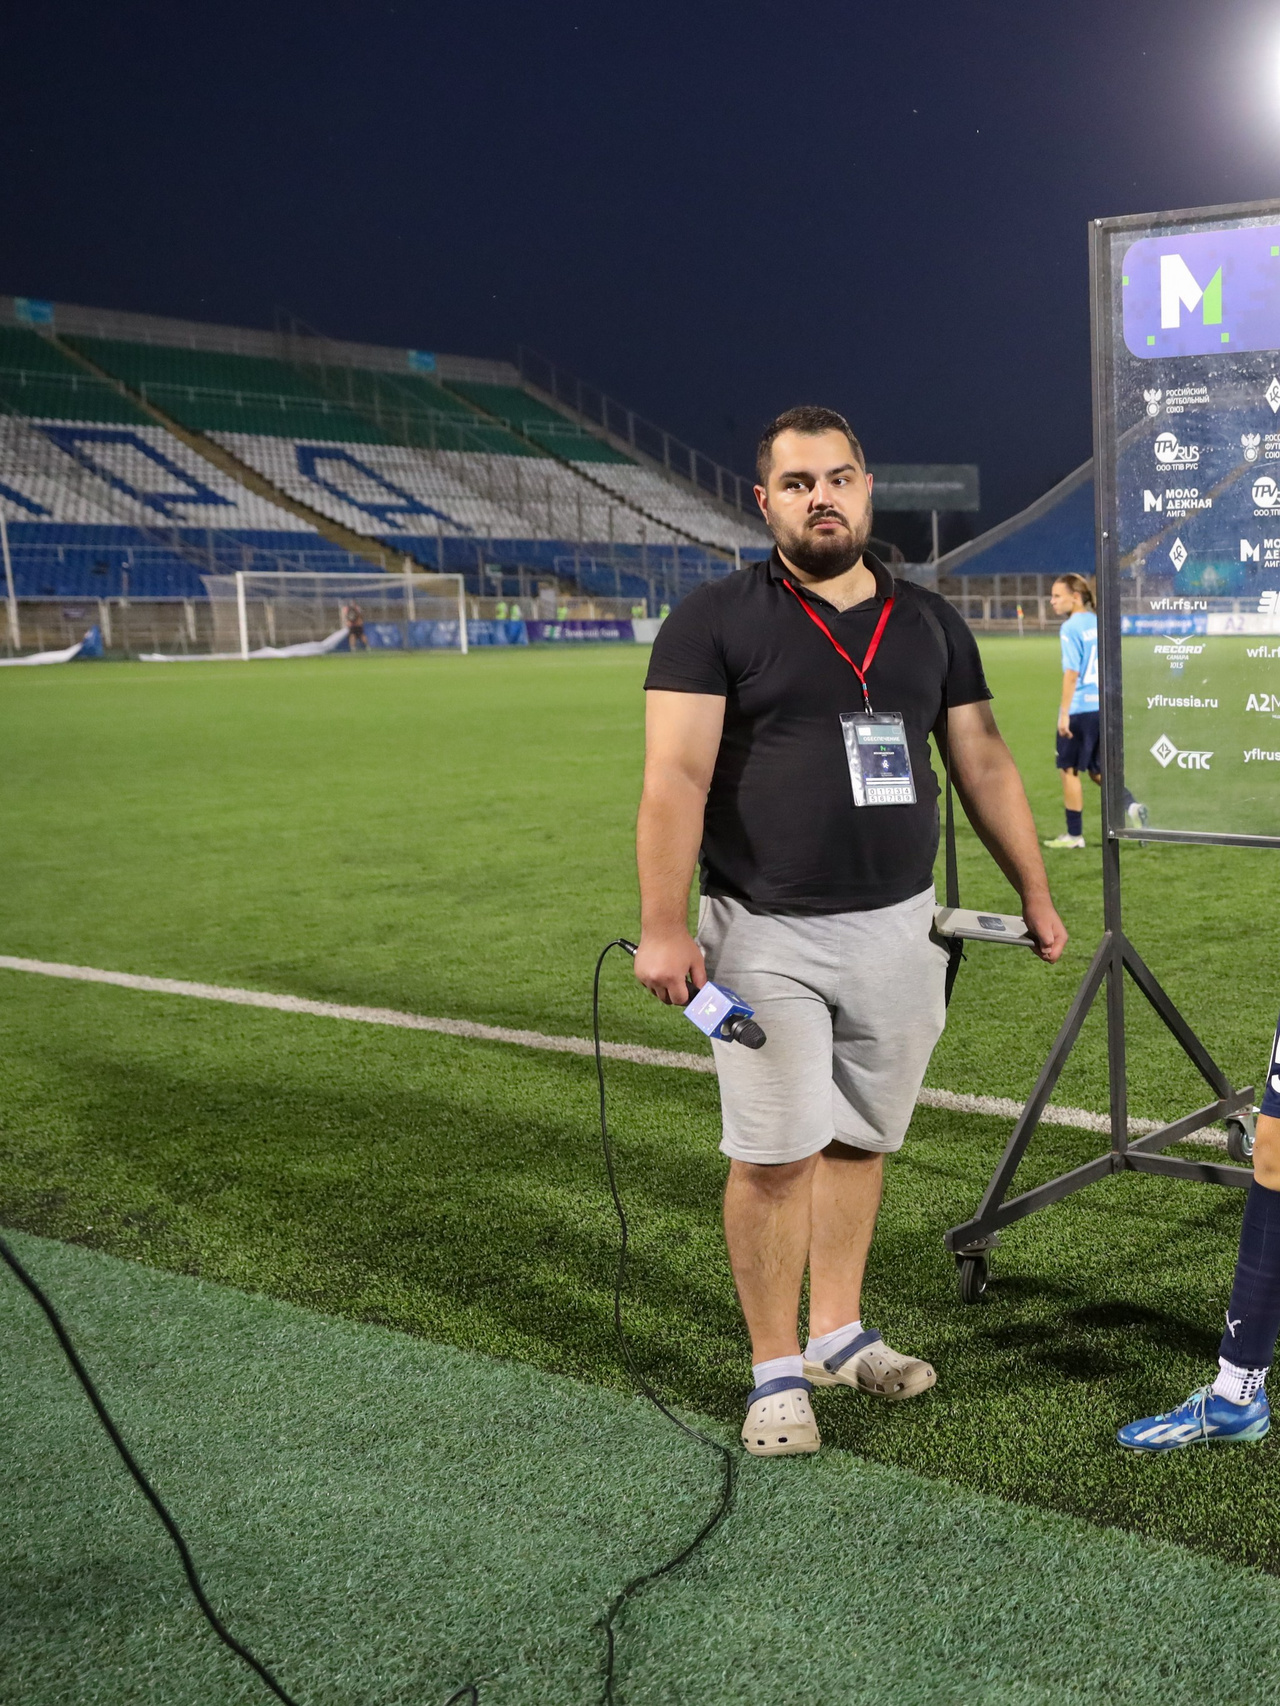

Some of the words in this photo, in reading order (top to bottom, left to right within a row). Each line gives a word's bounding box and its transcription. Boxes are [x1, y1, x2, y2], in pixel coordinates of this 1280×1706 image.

[1166, 489, 1198, 498] МОЛО
[1166, 499, 1212, 509] ДЕЖНАЯ
[1150, 599, 1207, 610] wfl.rfs.ru
[1154, 645, 1203, 654] RECORD
[1147, 695, 1218, 709] yflrussia.ru
